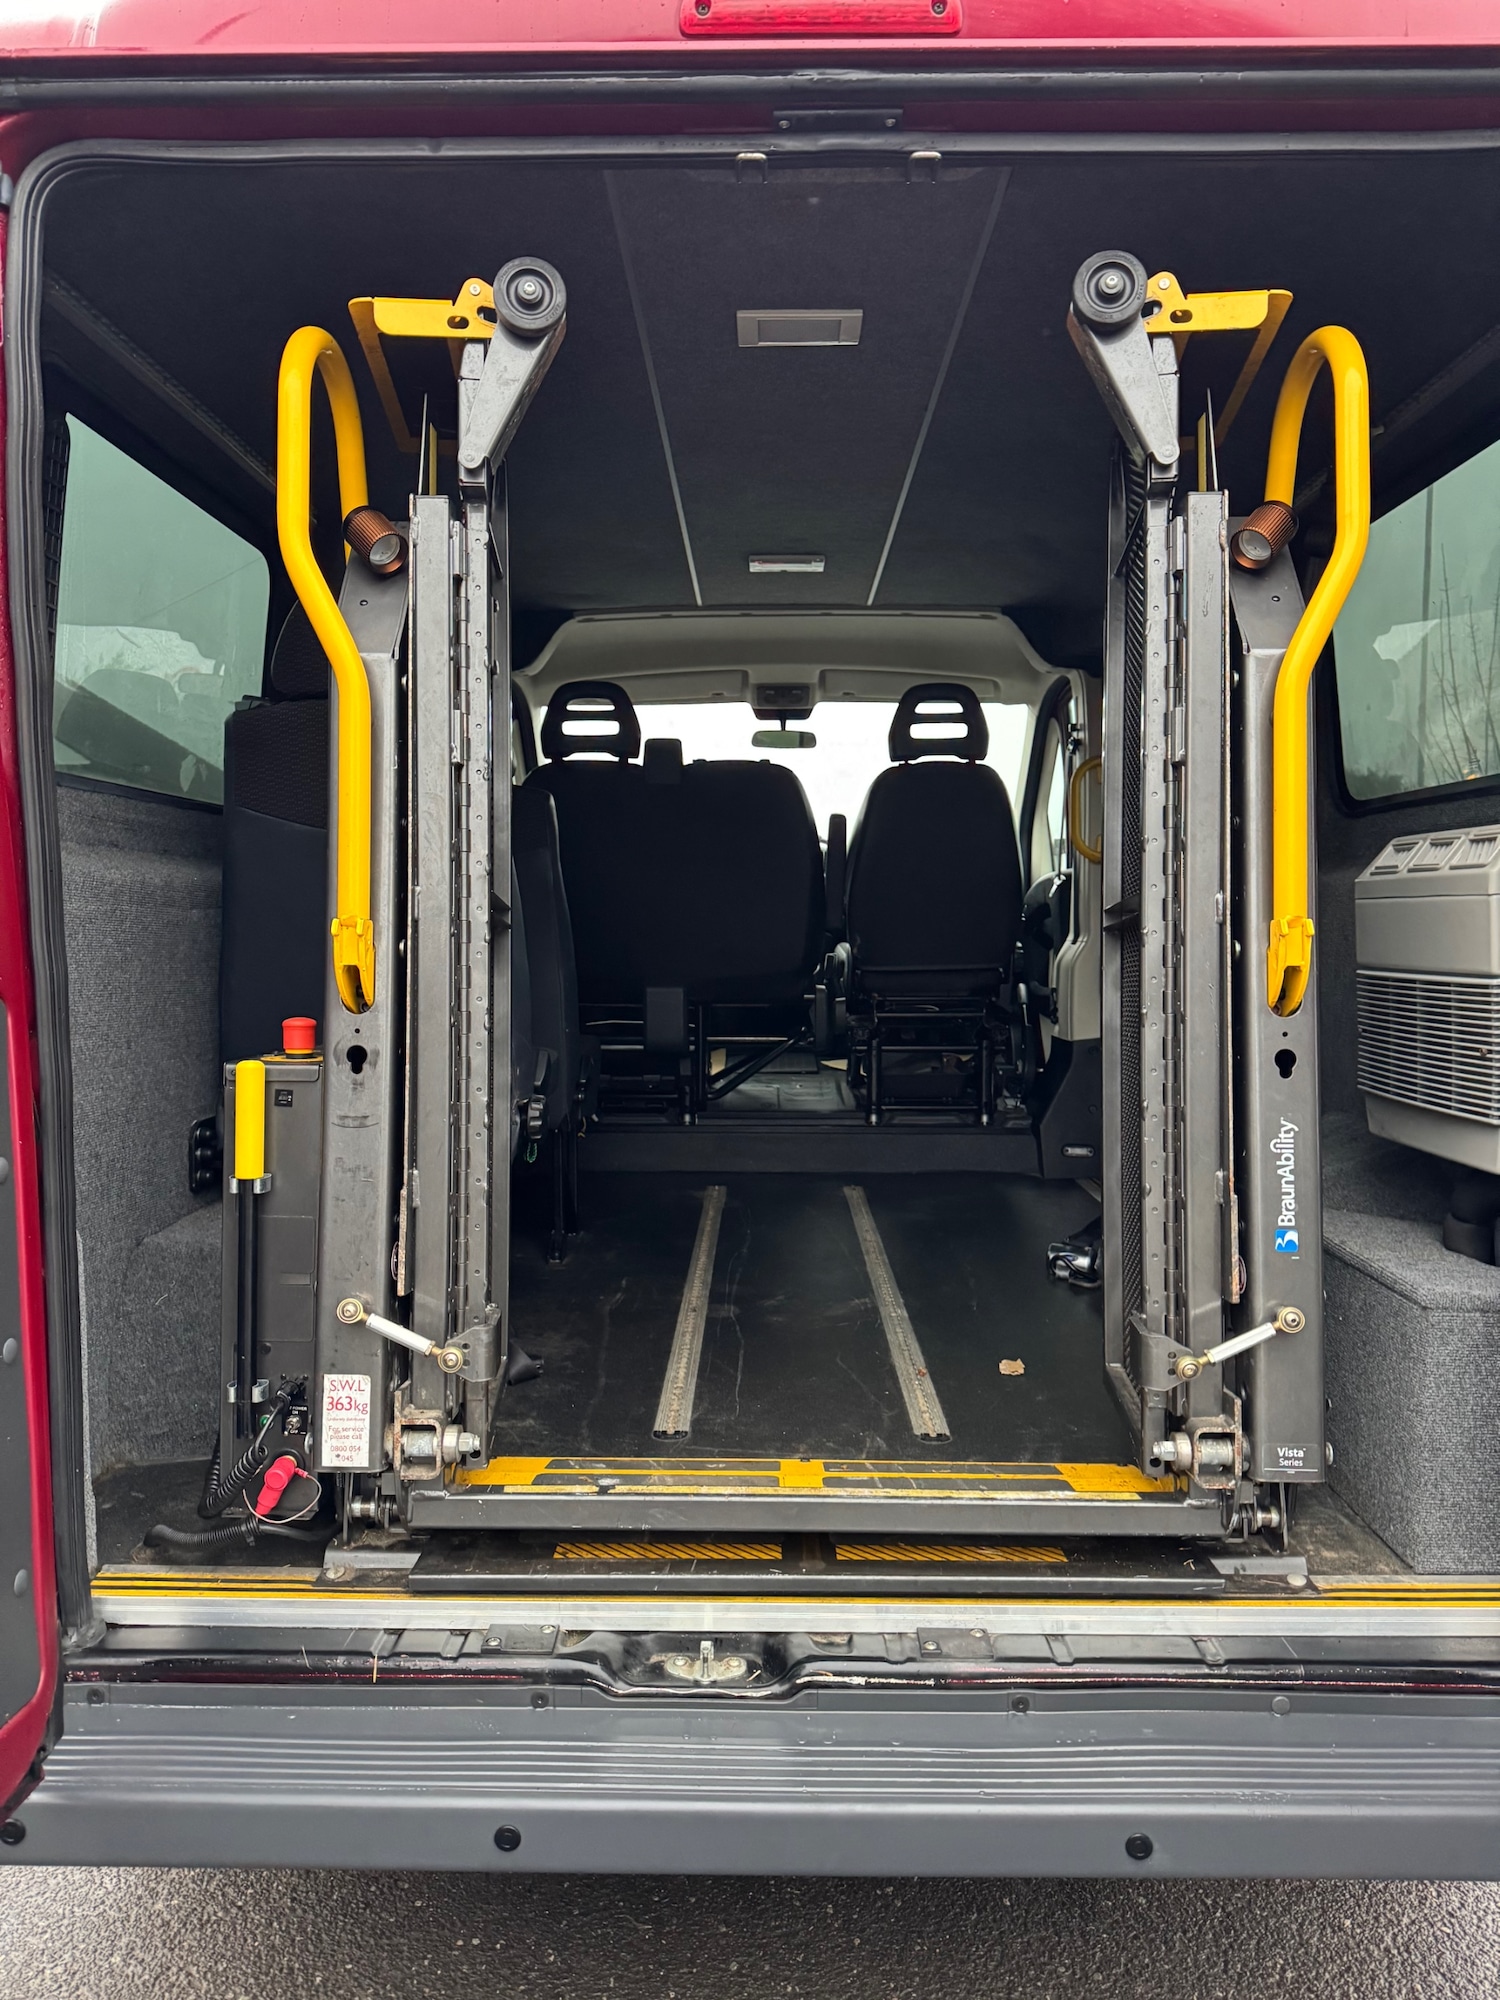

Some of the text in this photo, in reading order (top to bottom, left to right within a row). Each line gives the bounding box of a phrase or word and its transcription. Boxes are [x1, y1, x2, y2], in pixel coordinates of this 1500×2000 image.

[1269, 1117, 1299, 1226] BraunAbility
[329, 1379, 365, 1392] S.W.L
[326, 1395, 369, 1415] 363kg
[341, 1425, 365, 1433] service
[1277, 1446, 1304, 1457] Vista
[1279, 1457, 1303, 1466] Series
